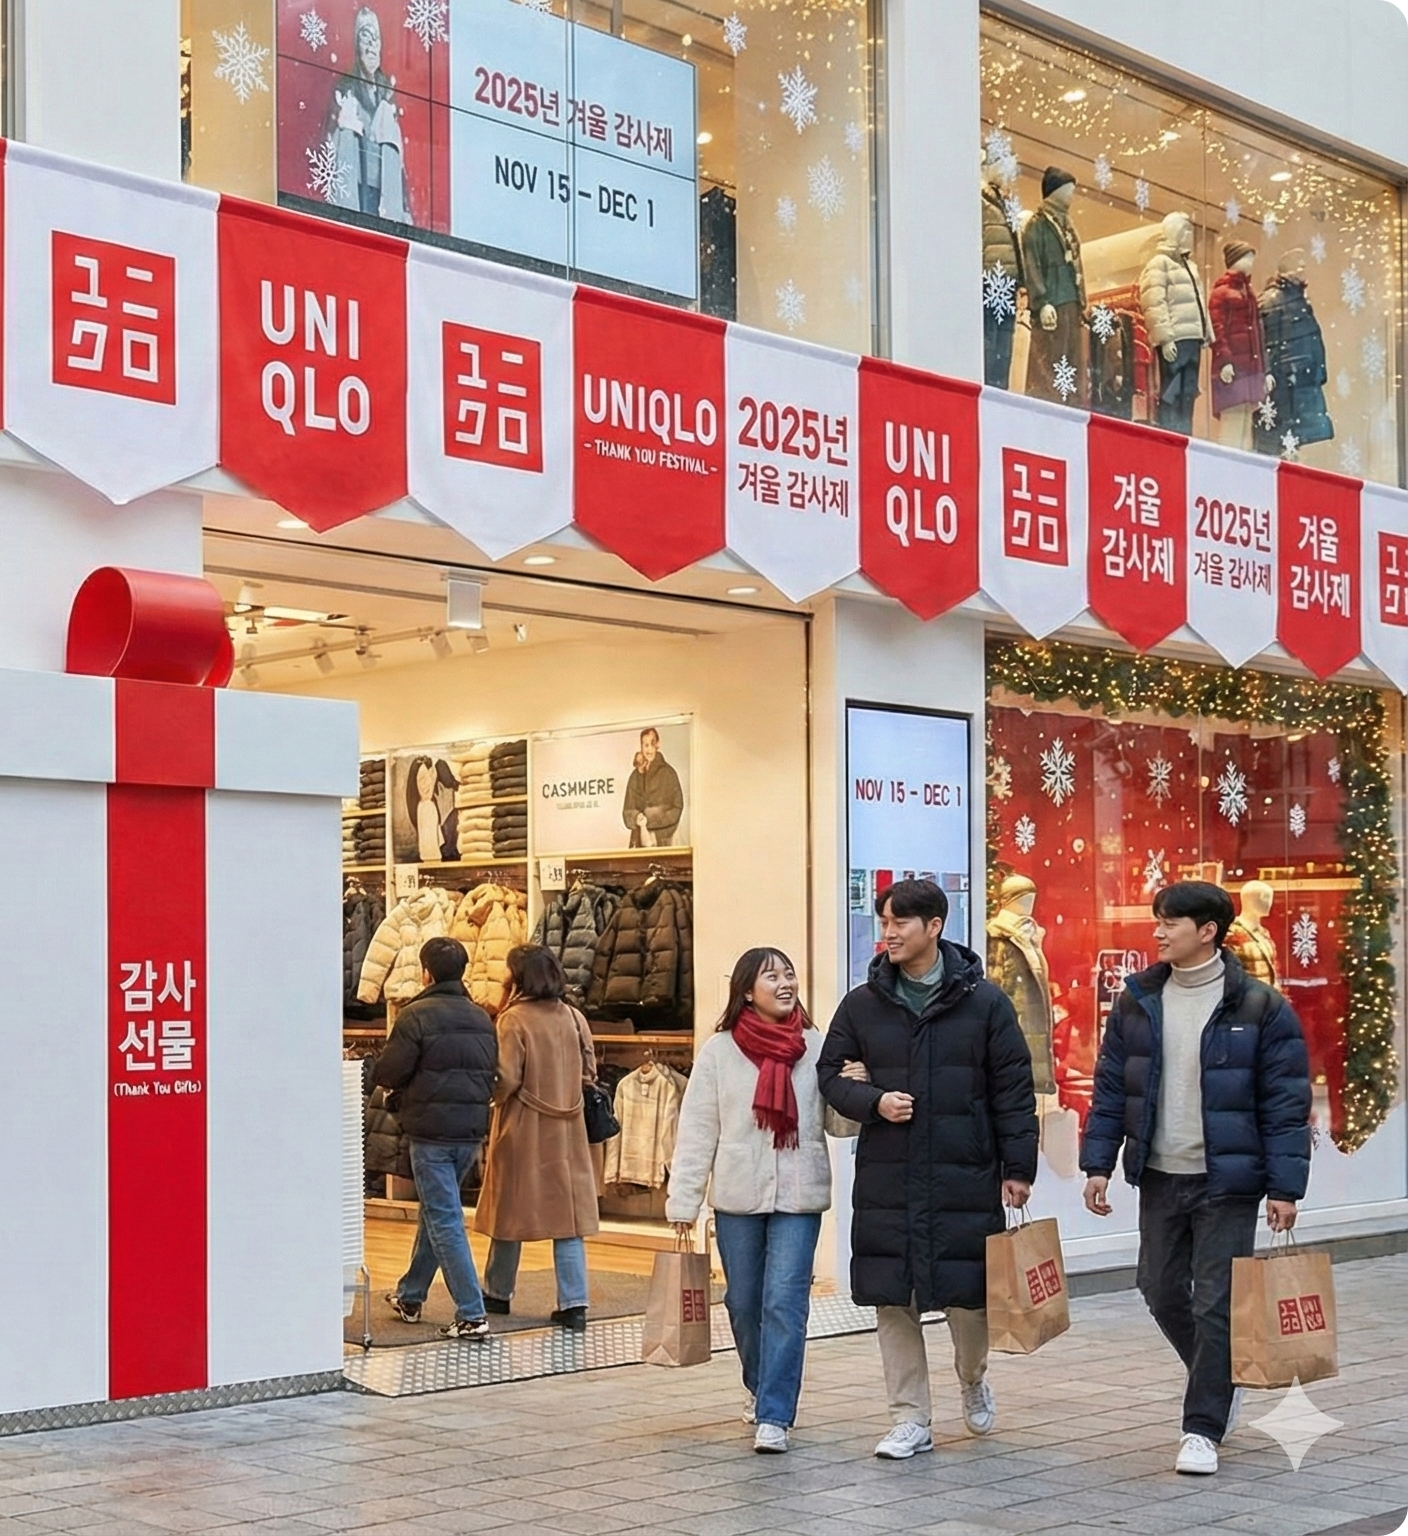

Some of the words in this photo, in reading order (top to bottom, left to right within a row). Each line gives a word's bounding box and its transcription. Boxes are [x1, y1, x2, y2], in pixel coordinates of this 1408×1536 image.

[474, 66, 560, 127] 2025년
[567, 98, 607, 142] 겨울
[614, 112, 673, 163] 감사제
[495, 155, 537, 194] NOV
[547, 170, 571, 204] 15
[599, 185, 638, 223] DEC
[647, 199, 654, 228] 1
[260, 280, 359, 360] UNI
[261, 361, 370, 436] QLO
[583, 373, 718, 446] UNIQLO
[594, 439, 631, 461] THANK
[634, 446, 656, 465] YOU
[658, 452, 708, 475] FESTIVAL
[737, 396, 849, 467] 2025년
[885, 421, 950, 484] UNI
[737, 462, 780, 505] 겨울
[787, 470, 849, 518] 감사제
[886, 484, 958, 547] QLO
[1113, 472, 1161, 527] 겨울
[1194, 495, 1271, 553] 2025년
[1297, 515, 1339, 564] 겨울
[1101, 527, 1174, 586] 감사제
[1194, 552, 1224, 586] 겨울
[1228, 557, 1272, 596] 감사제
[1290, 564, 1351, 618] 감사제
[855, 779, 883, 801] NOV
[891, 781, 905, 804] 15
[924, 783, 950, 806] DEC
[956, 785, 961, 806] 1
[119, 960, 196, 1012] 감사
[118, 1020, 196, 1071] 선물
[153, 1081, 171, 1095] You
